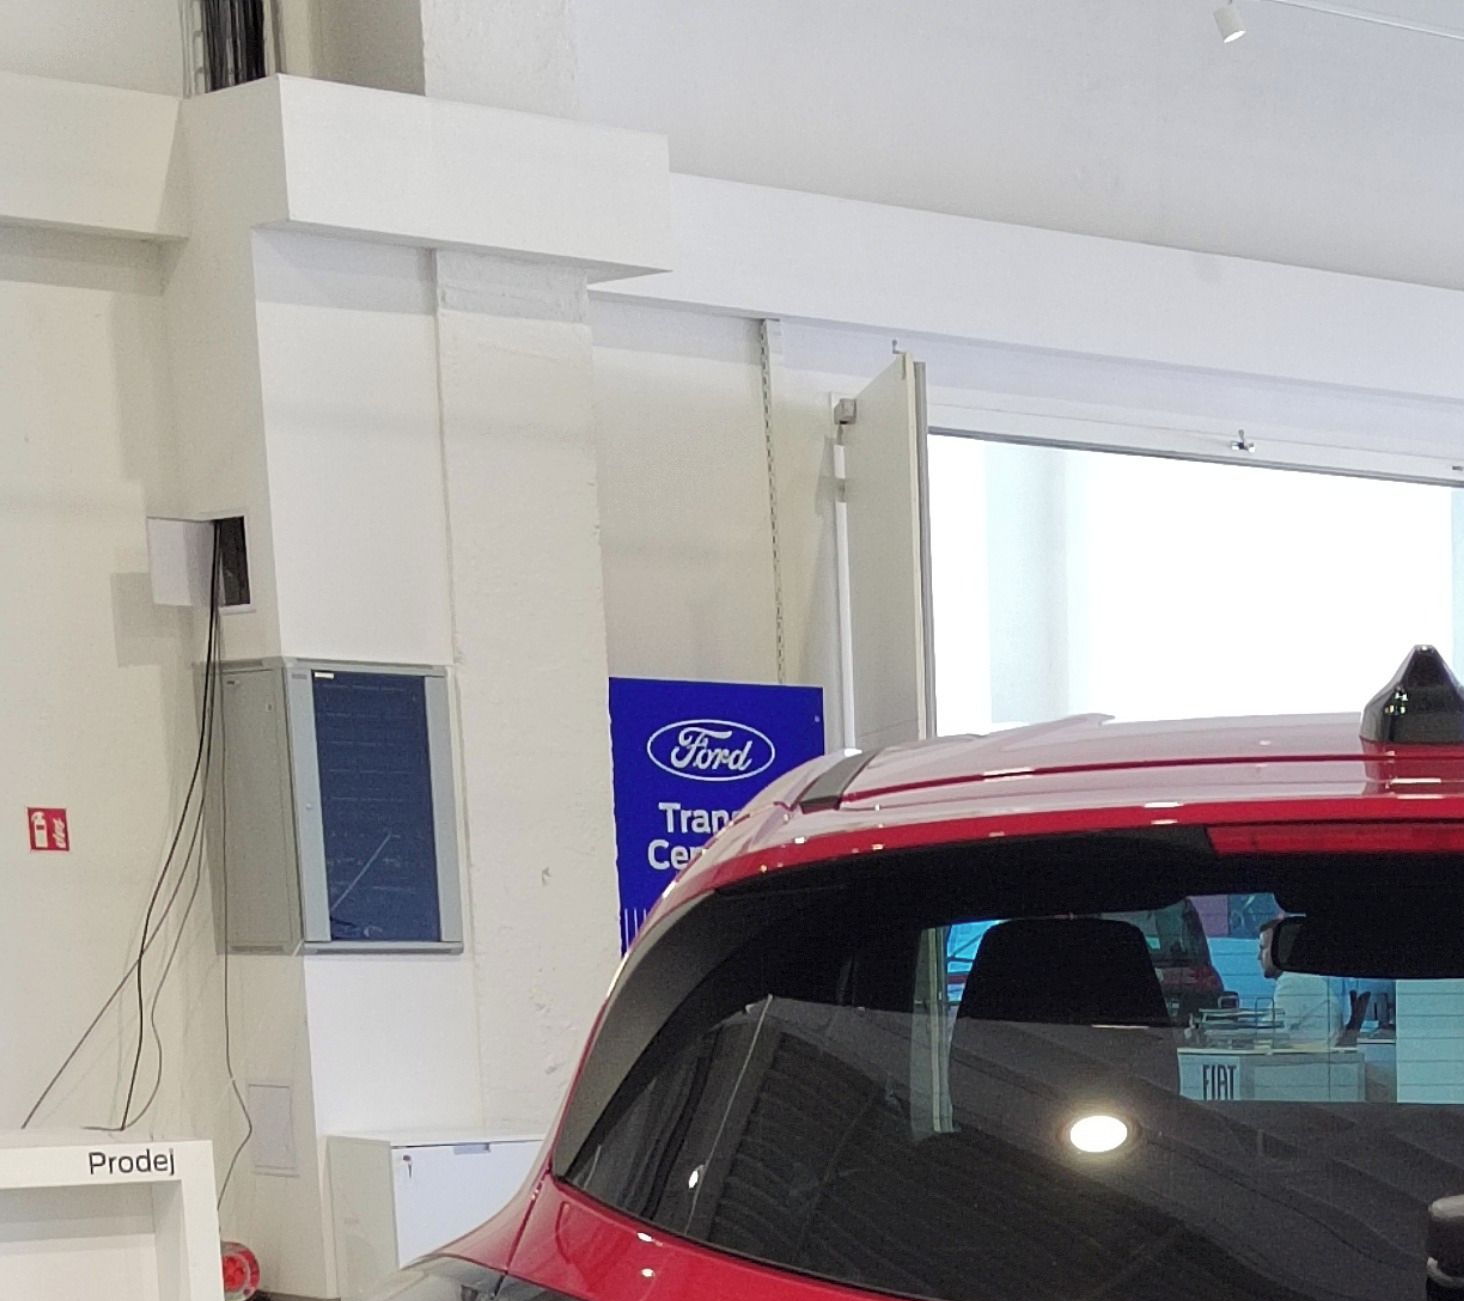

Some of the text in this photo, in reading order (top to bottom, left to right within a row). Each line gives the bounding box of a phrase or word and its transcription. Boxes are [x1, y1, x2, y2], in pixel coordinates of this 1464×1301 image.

[670, 726, 752, 770] Ford
[1202, 1064, 1236, 1100] FIAT
[88, 1148, 175, 1176] Prodej
